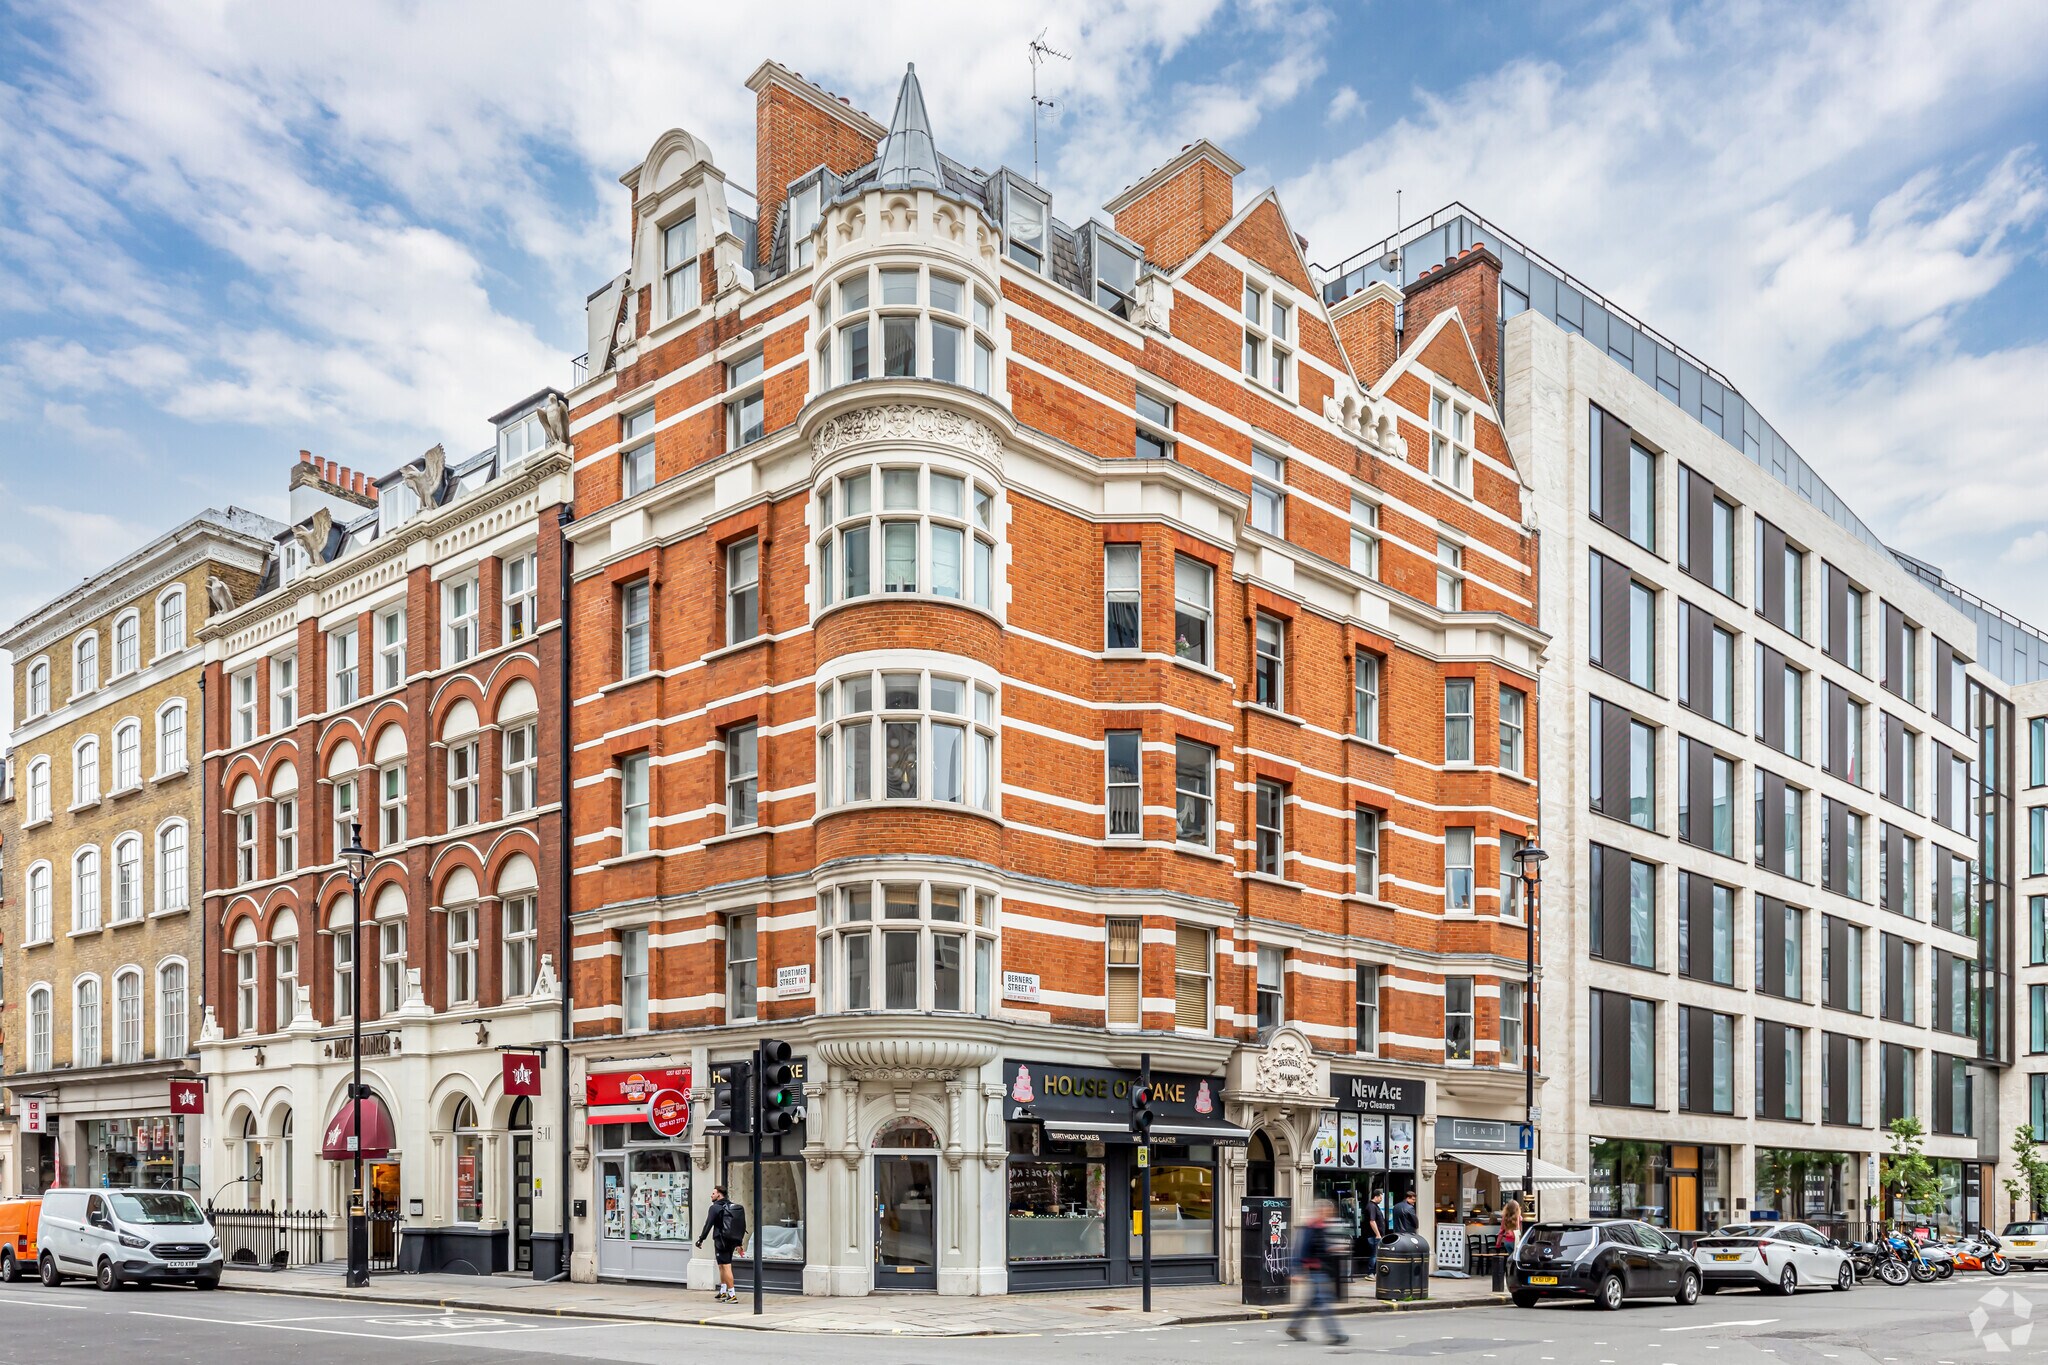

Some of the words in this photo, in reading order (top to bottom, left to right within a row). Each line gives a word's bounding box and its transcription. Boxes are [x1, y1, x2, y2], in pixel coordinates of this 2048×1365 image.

[779, 967, 807, 978] MORTIMER
[779, 977, 797, 987] STREET
[798, 976, 806, 984] W1
[1007, 974, 1033, 985] BERNERS
[1007, 983, 1028, 993] STREET
[1029, 985, 1037, 993] W1
[1277, 1058, 1301, 1069] BERNERS
[619, 1081, 644, 1094] Burger
[644, 1079, 658, 1092] Bro
[1044, 1074, 1108, 1098] HOUSE
[1148, 1083, 1186, 1103] AKE
[653, 1105, 675, 1117] Burger
[675, 1102, 686, 1111] Bro
[1357, 1100, 1369, 1110] Dry
[1369, 1100, 1395, 1110] Cleaners
[1457, 1126, 1502, 1136] PLENTY
[1158, 1136, 1176, 1144] CAKES
